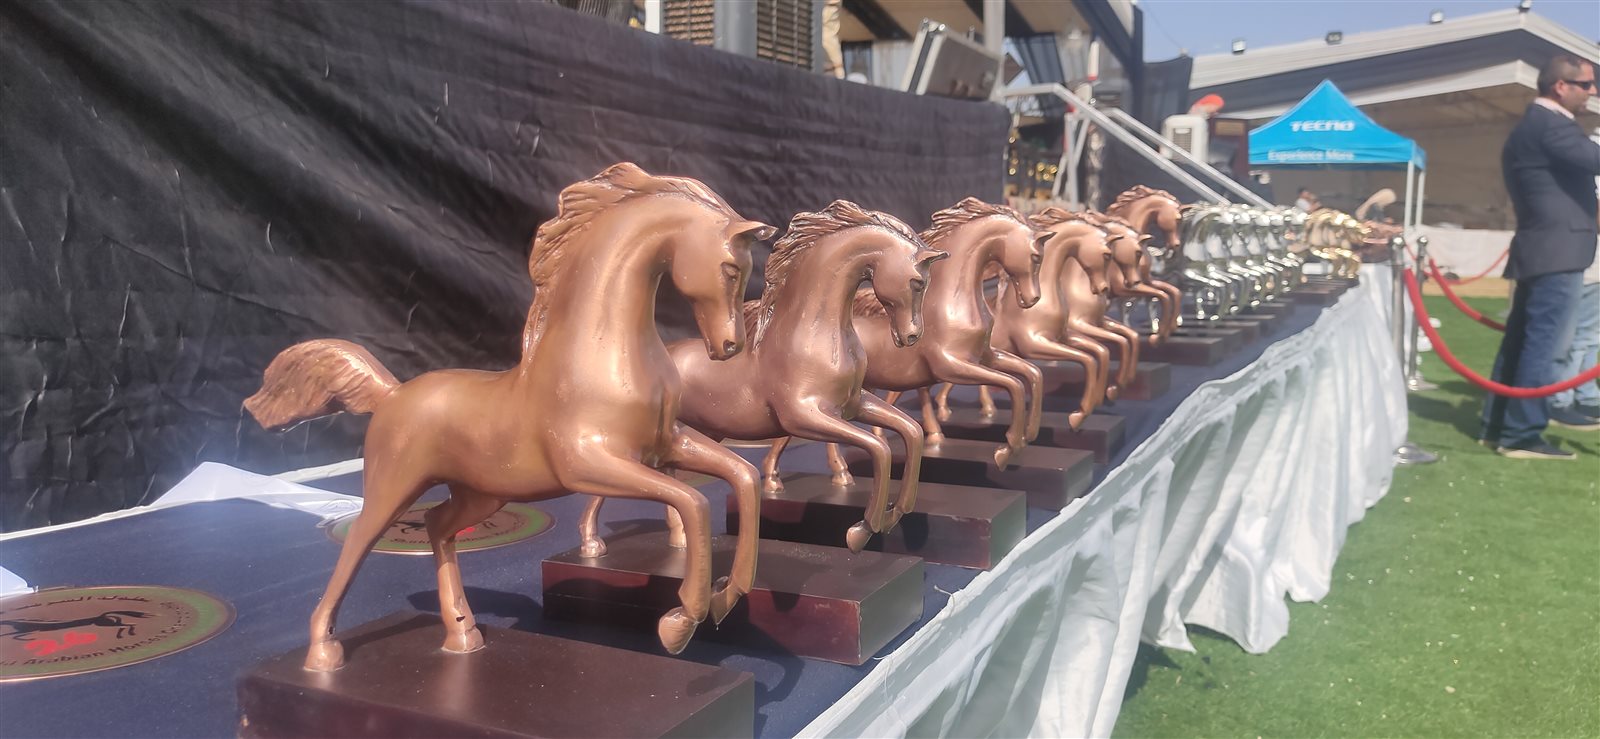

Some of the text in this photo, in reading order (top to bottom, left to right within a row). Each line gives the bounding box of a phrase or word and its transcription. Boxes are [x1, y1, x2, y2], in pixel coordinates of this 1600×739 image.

[1290, 120, 1355, 132] TECNO
[1267, 149, 1355, 162] Experience More
[23, 651, 104, 666] Arabian
